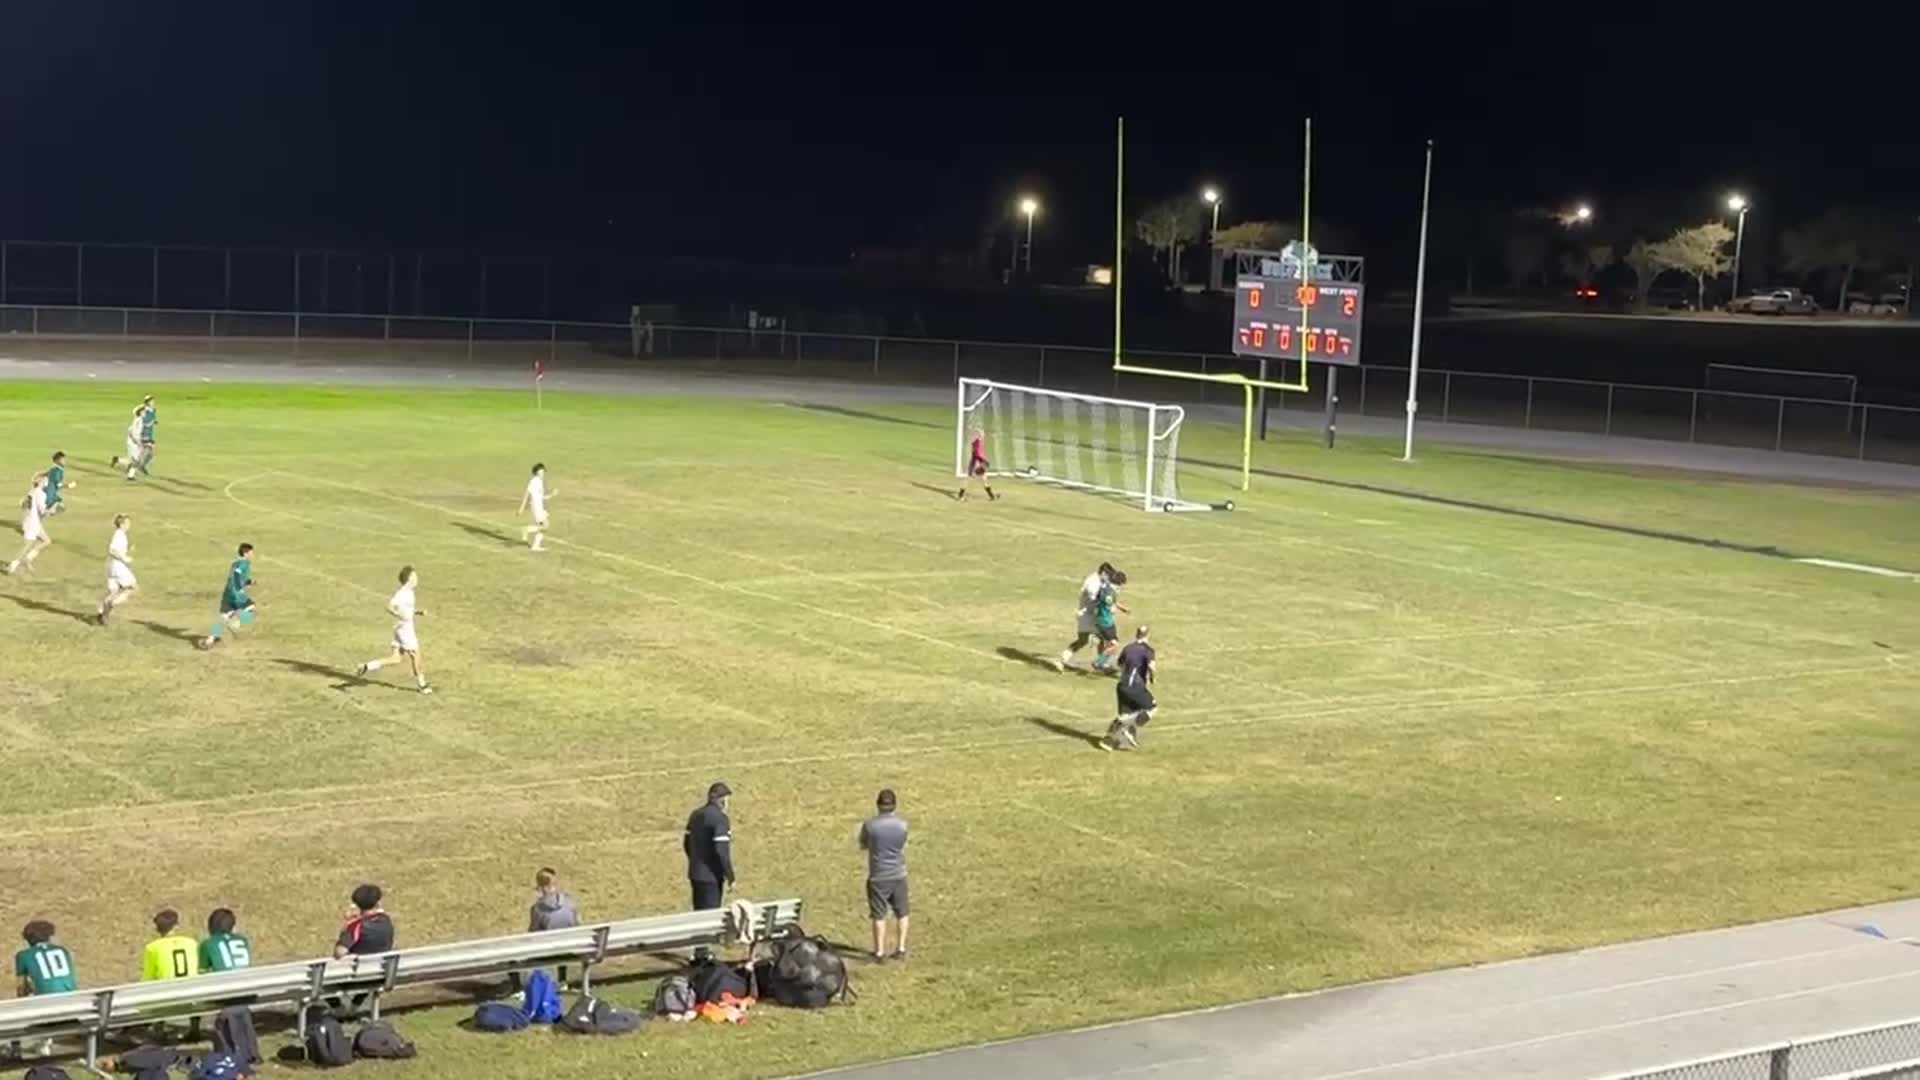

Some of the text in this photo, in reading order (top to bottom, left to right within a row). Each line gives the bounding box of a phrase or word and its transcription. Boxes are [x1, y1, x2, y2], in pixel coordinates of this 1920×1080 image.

[1250, 289, 1260, 308] 0
[1343, 296, 1354, 315] 2
[1254, 330, 1263, 347] 0
[1280, 331, 1289, 350] 0
[1307, 334, 1317, 352] 0
[1326, 336, 1335, 353] 0
[172, 949, 188, 978] 0
[219, 940, 250, 968] 15
[35, 949, 70, 980] 10
